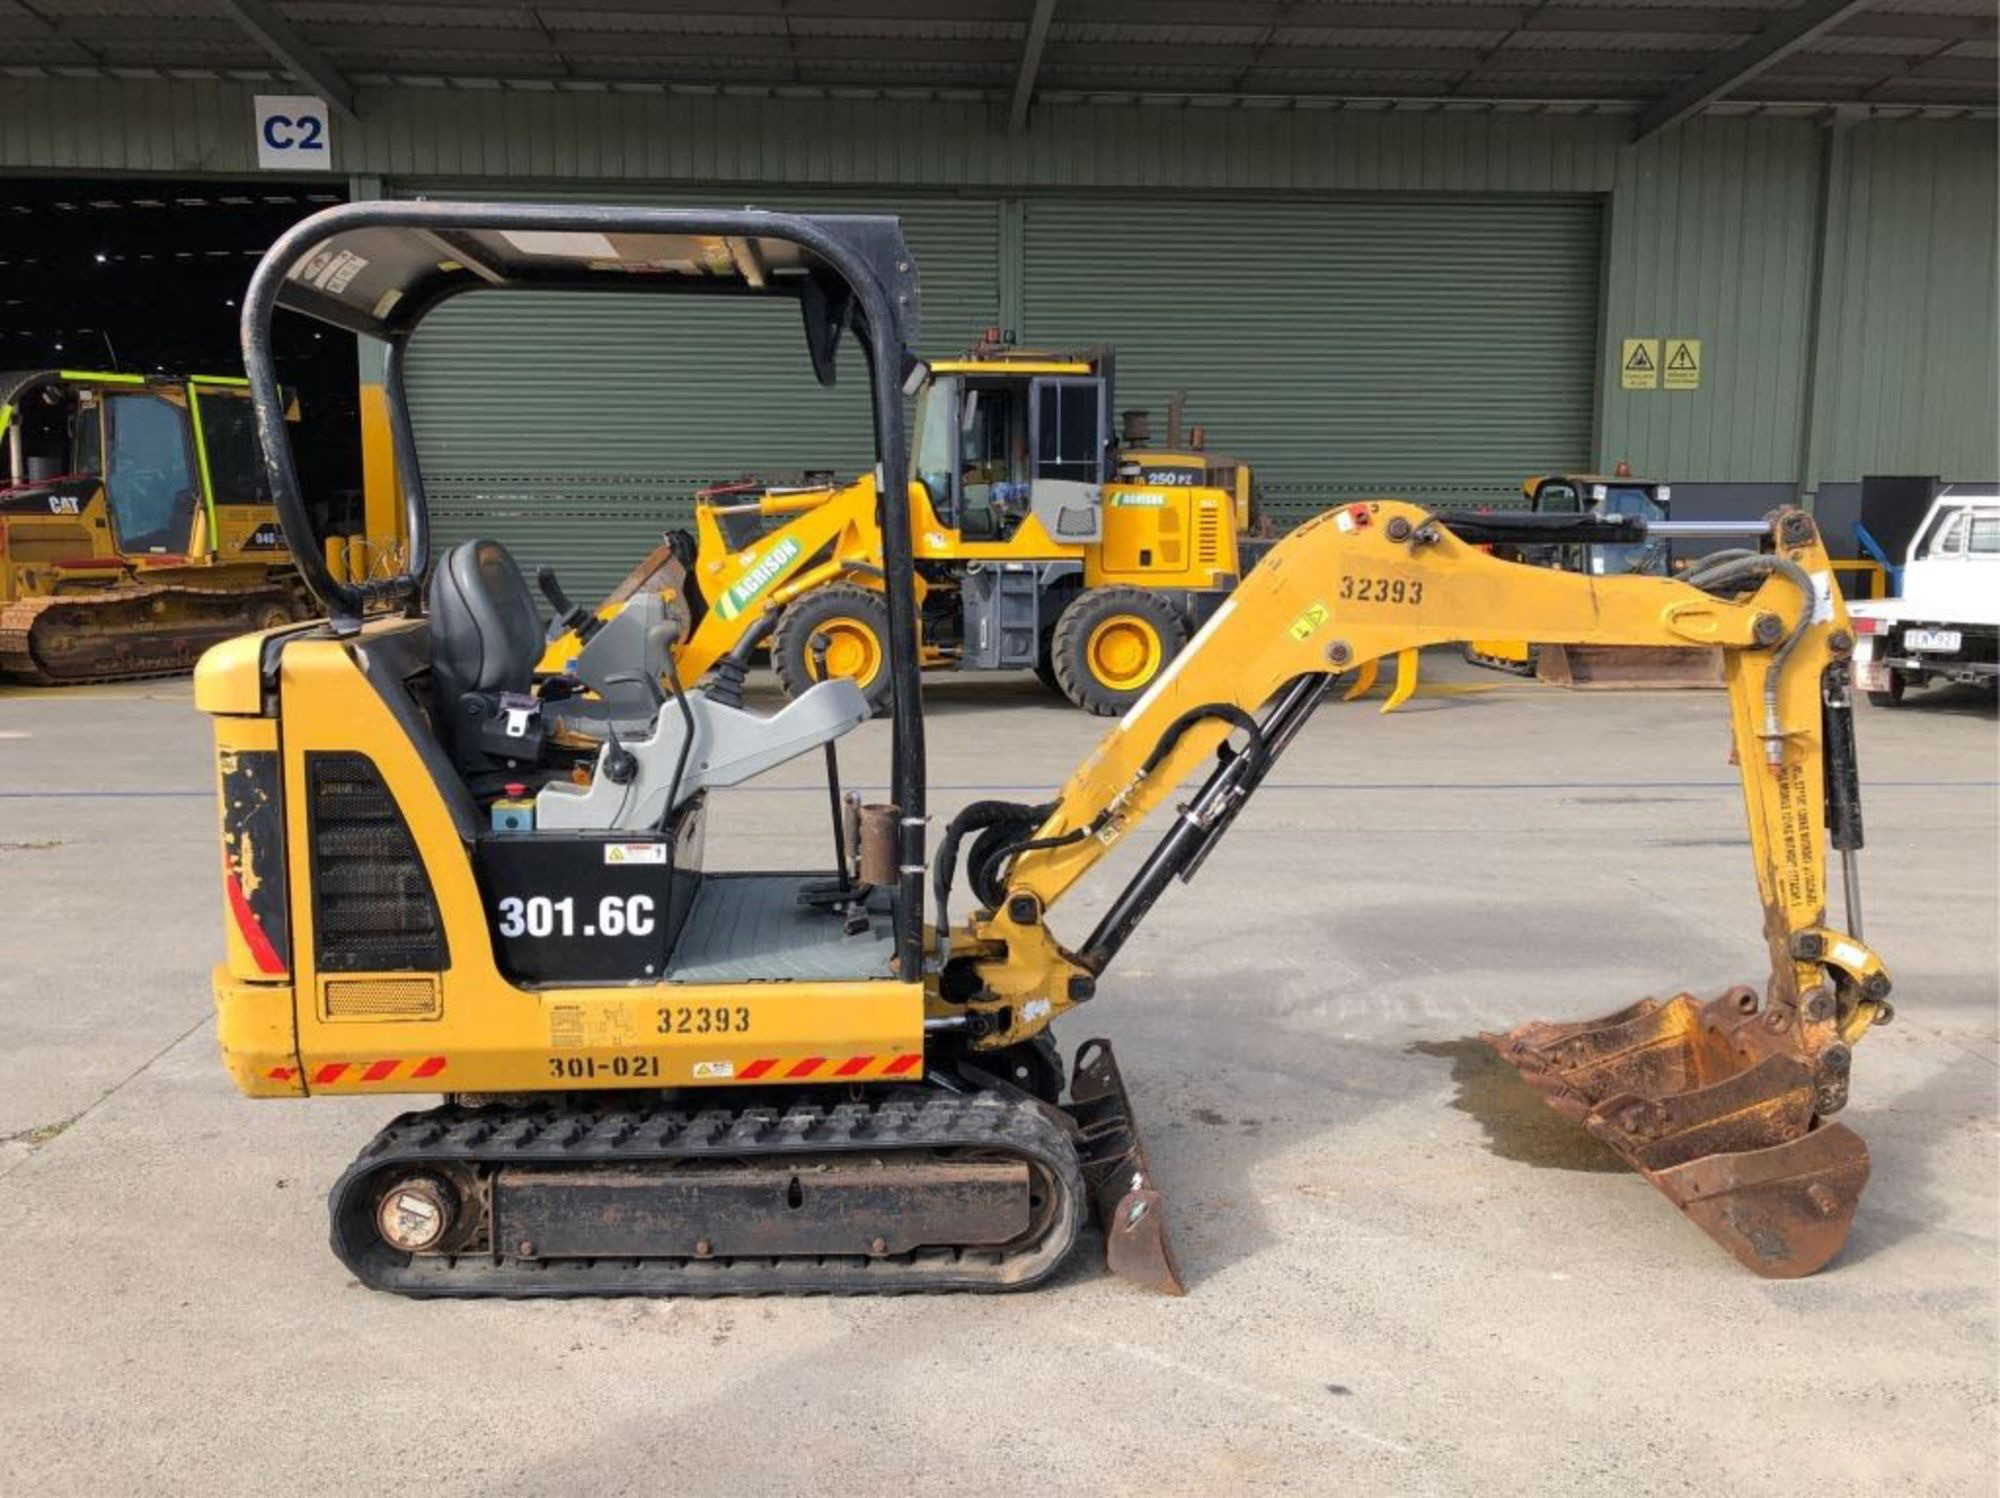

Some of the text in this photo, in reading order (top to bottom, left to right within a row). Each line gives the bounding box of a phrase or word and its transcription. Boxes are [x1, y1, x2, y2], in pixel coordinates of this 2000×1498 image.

[263, 115, 323, 149] C2
[1148, 472, 1176, 485] 250
[48, 495, 79, 514] CAT
[735, 538, 798, 602] AGRISON
[1340, 576, 1424, 605] 32393
[499, 894, 656, 938] 301.6C
[657, 1006, 751, 1034] 32393
[548, 1055, 660, 1079] 301-021
